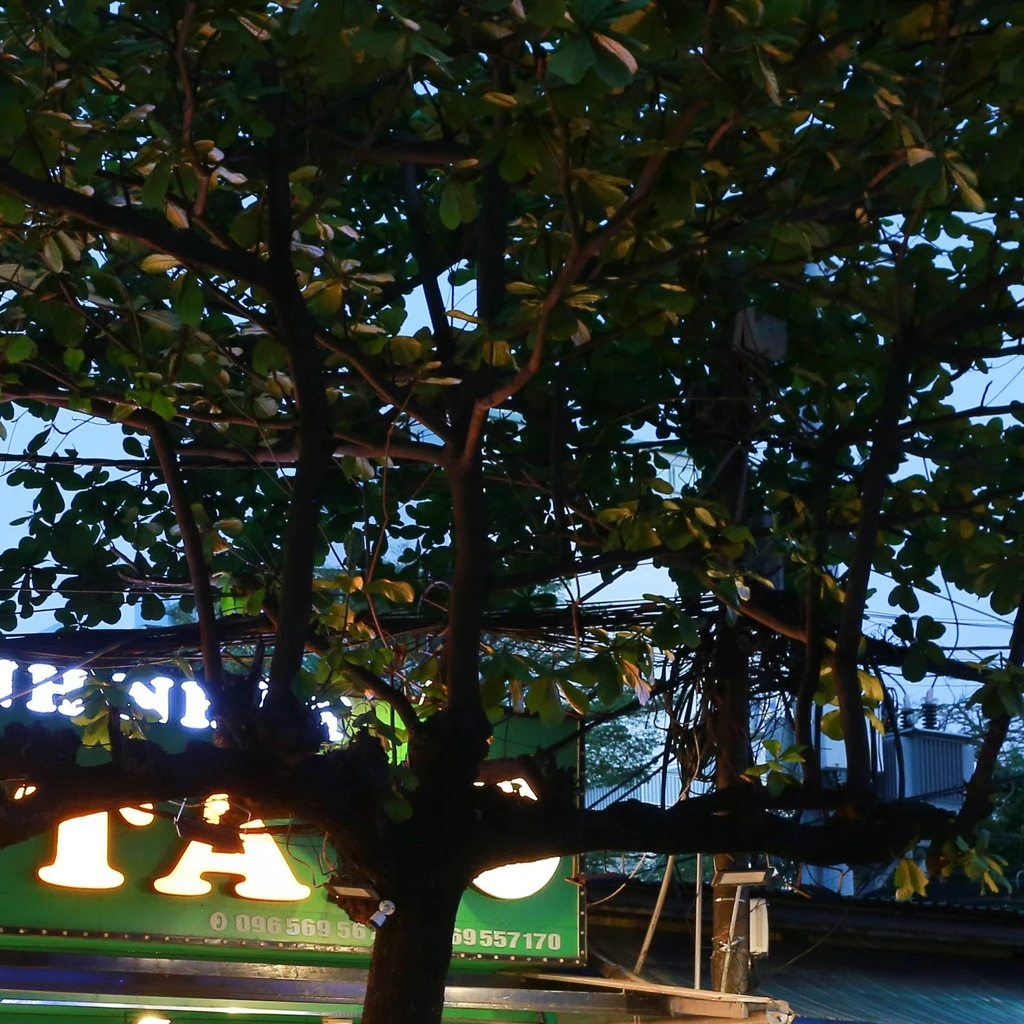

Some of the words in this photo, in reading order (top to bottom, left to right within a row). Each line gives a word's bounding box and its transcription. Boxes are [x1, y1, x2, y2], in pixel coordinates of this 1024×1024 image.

[234, 914, 282, 934] 096
[286, 917, 331, 938] 569
[336, 921, 376, 941] 56
